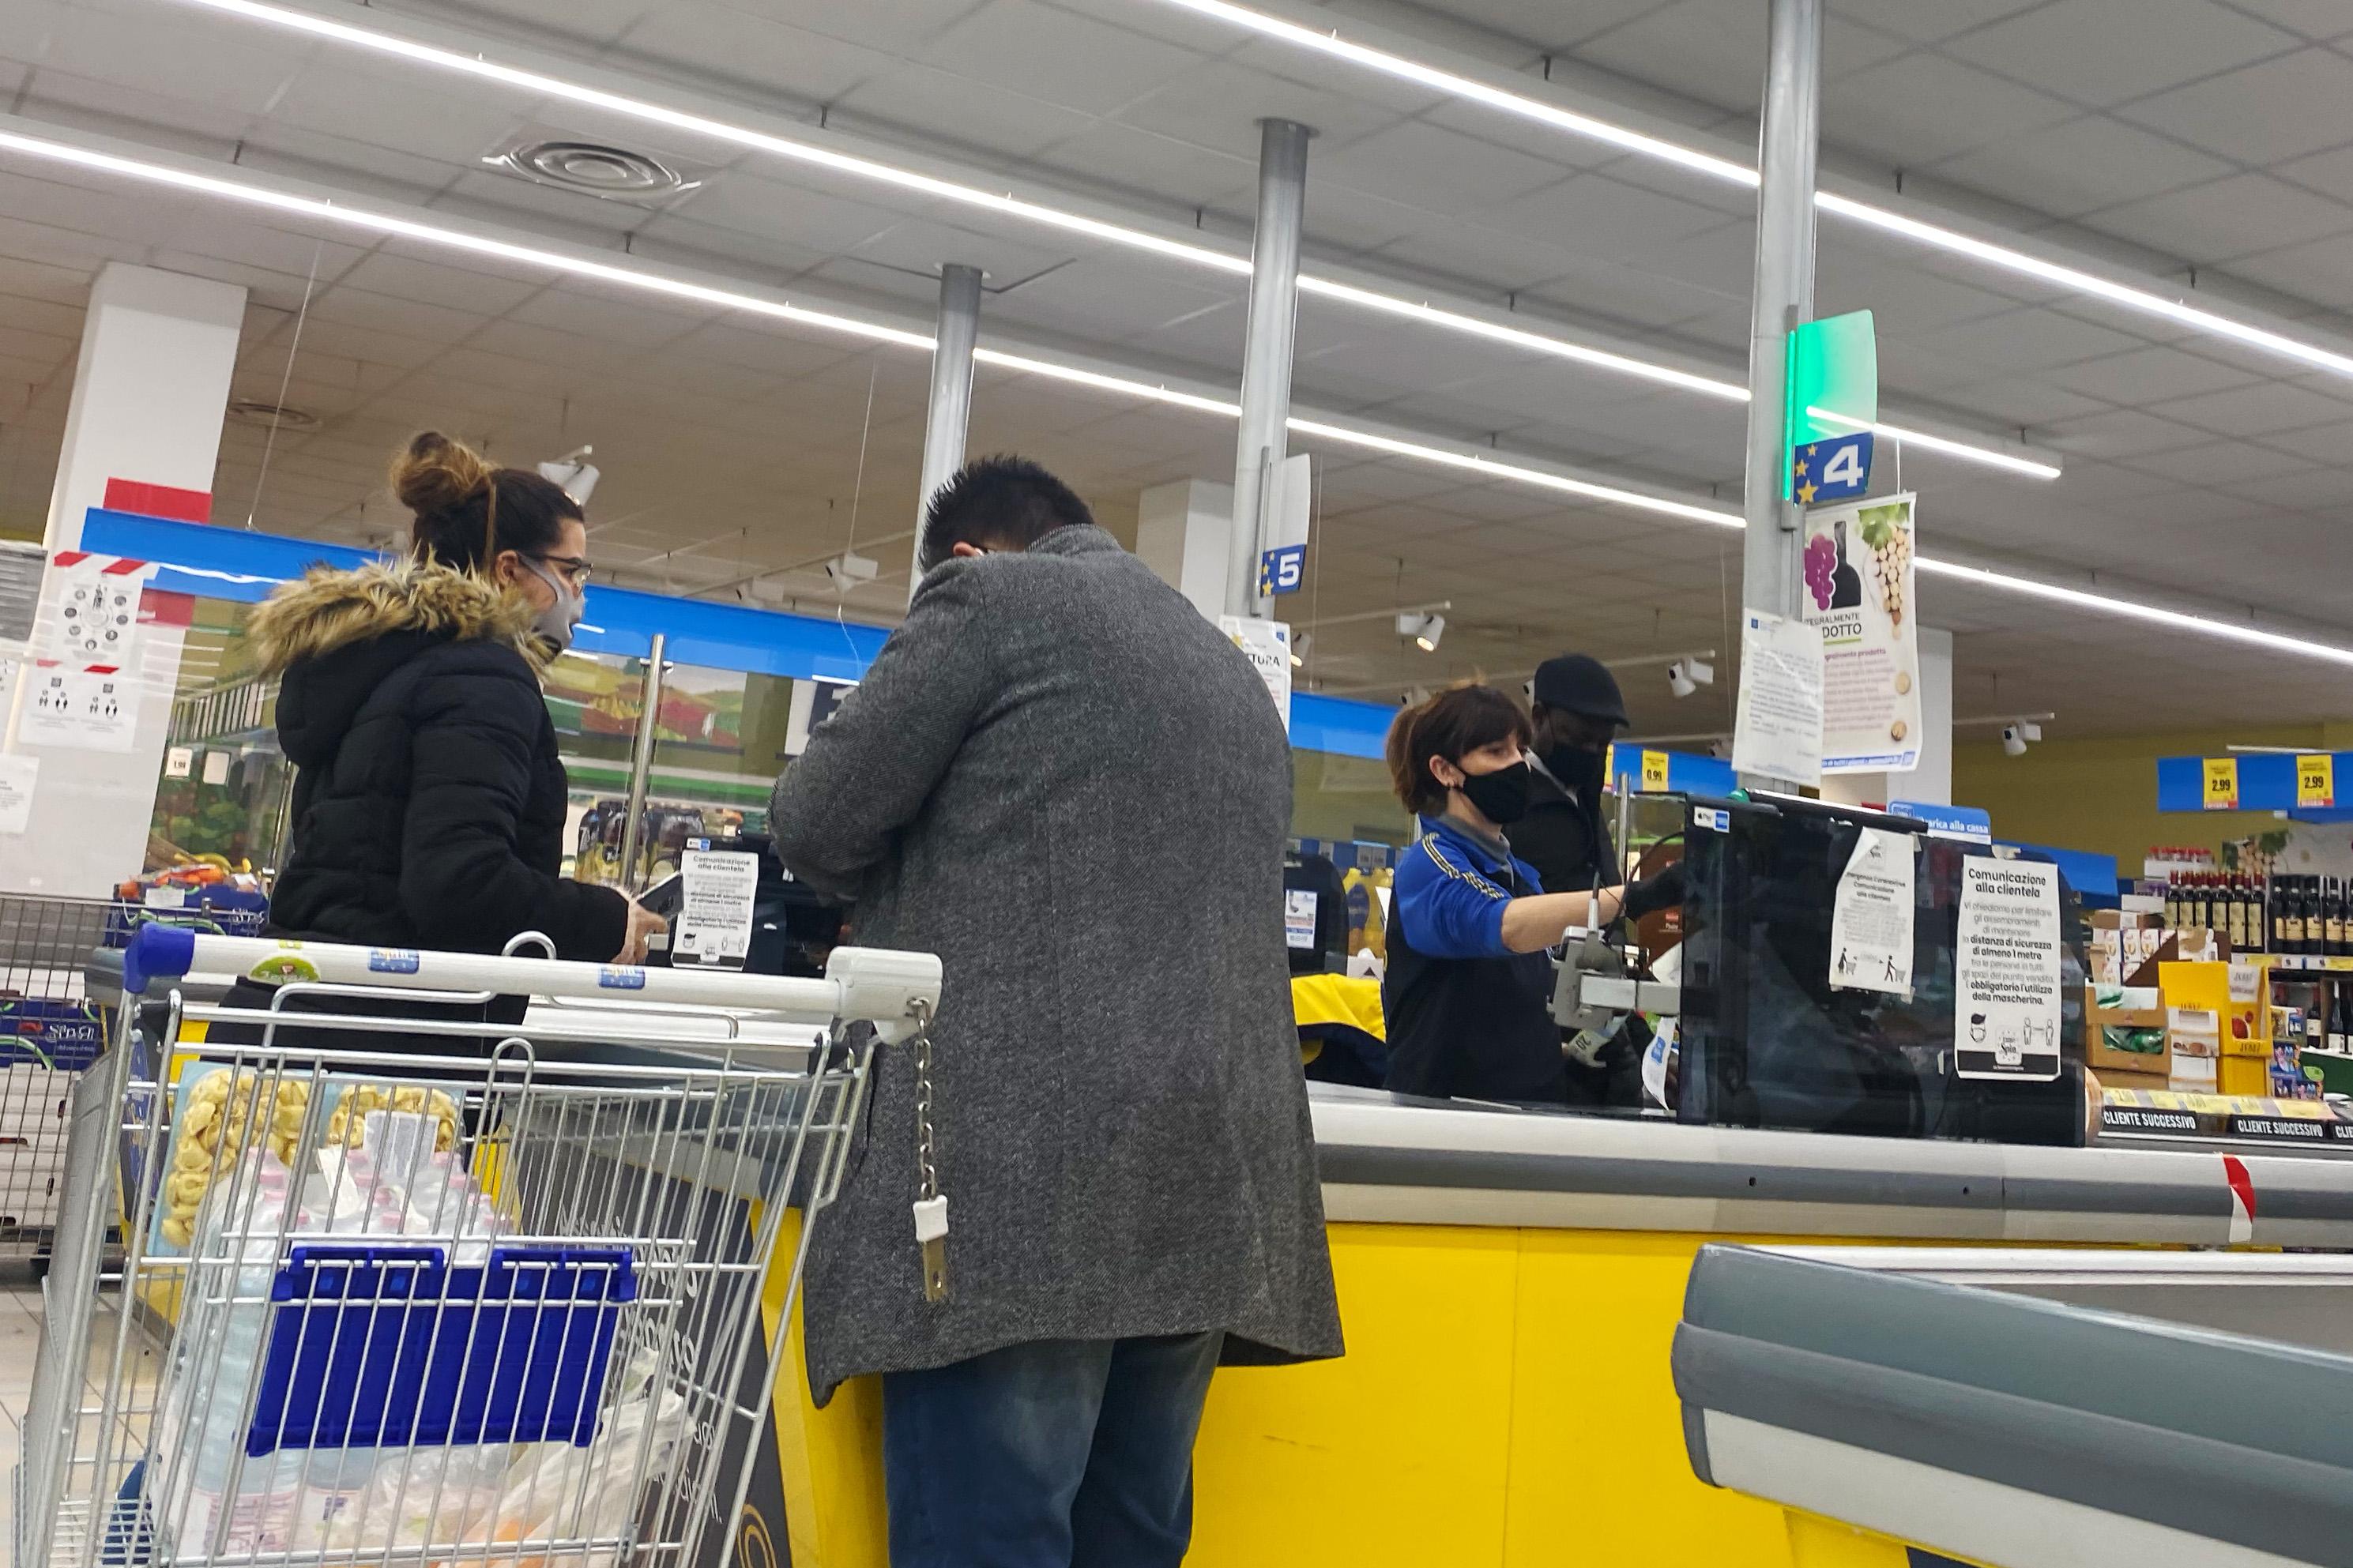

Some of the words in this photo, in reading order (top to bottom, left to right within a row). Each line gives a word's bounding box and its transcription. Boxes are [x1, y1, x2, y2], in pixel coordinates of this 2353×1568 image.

[1823, 444, 1864, 487] 4
[1278, 552, 1300, 587] 5
[1805, 612, 1860, 626] TEGRALMENTE
[1822, 622, 1862, 638] DOTTO
[1247, 652, 1280, 667] TURA
[2212, 779, 2231, 792] 2.99
[2303, 776, 2325, 789] 2.99
[1968, 867, 2046, 886] Comunicazione
[1975, 882, 1995, 893] alla
[1997, 882, 2041, 898] clientela
[1971, 934, 2005, 946] distanza
[2005, 937, 2013, 947] di
[2014, 938, 2053, 950] sicurezza
[1972, 946, 1980, 956] di
[1981, 947, 2012, 959] almeno
[2017, 950, 2042, 961] metro
[1971, 980, 2020, 994] obbligatorio
[1972, 992, 1991, 1002] della
[2103, 1110, 2141, 1126] CLIENTE
[2141, 1112, 2197, 1130] SUCCESSIVO
[2237, 1119, 2273, 1135] CLIENTE
[2273, 1121, 2324, 1137] SUCCESSIVO
[2335, 1125, 2353, 1138] CLIE
